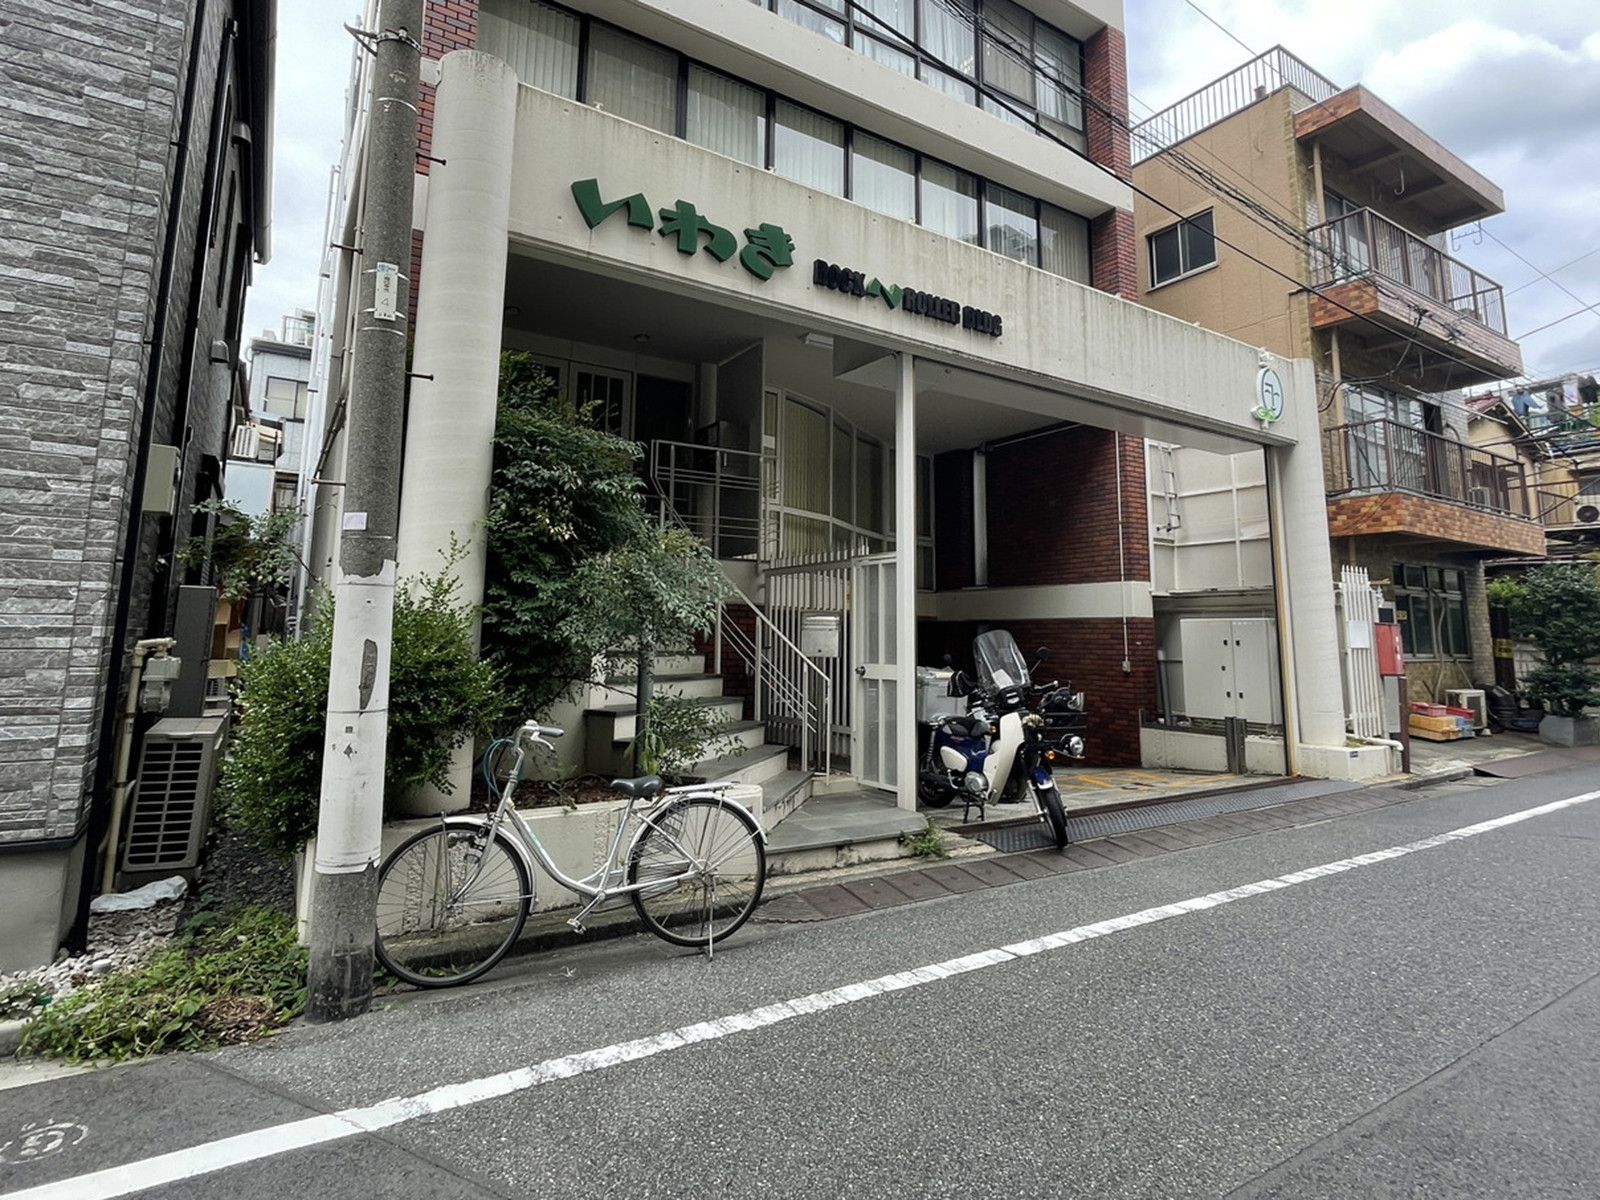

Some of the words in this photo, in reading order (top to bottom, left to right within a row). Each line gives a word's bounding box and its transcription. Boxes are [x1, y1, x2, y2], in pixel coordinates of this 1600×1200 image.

[571, 178, 796, 281] いわき
[813, 259, 867, 298] ROCK
[962, 305, 1003, 337] BLDG
